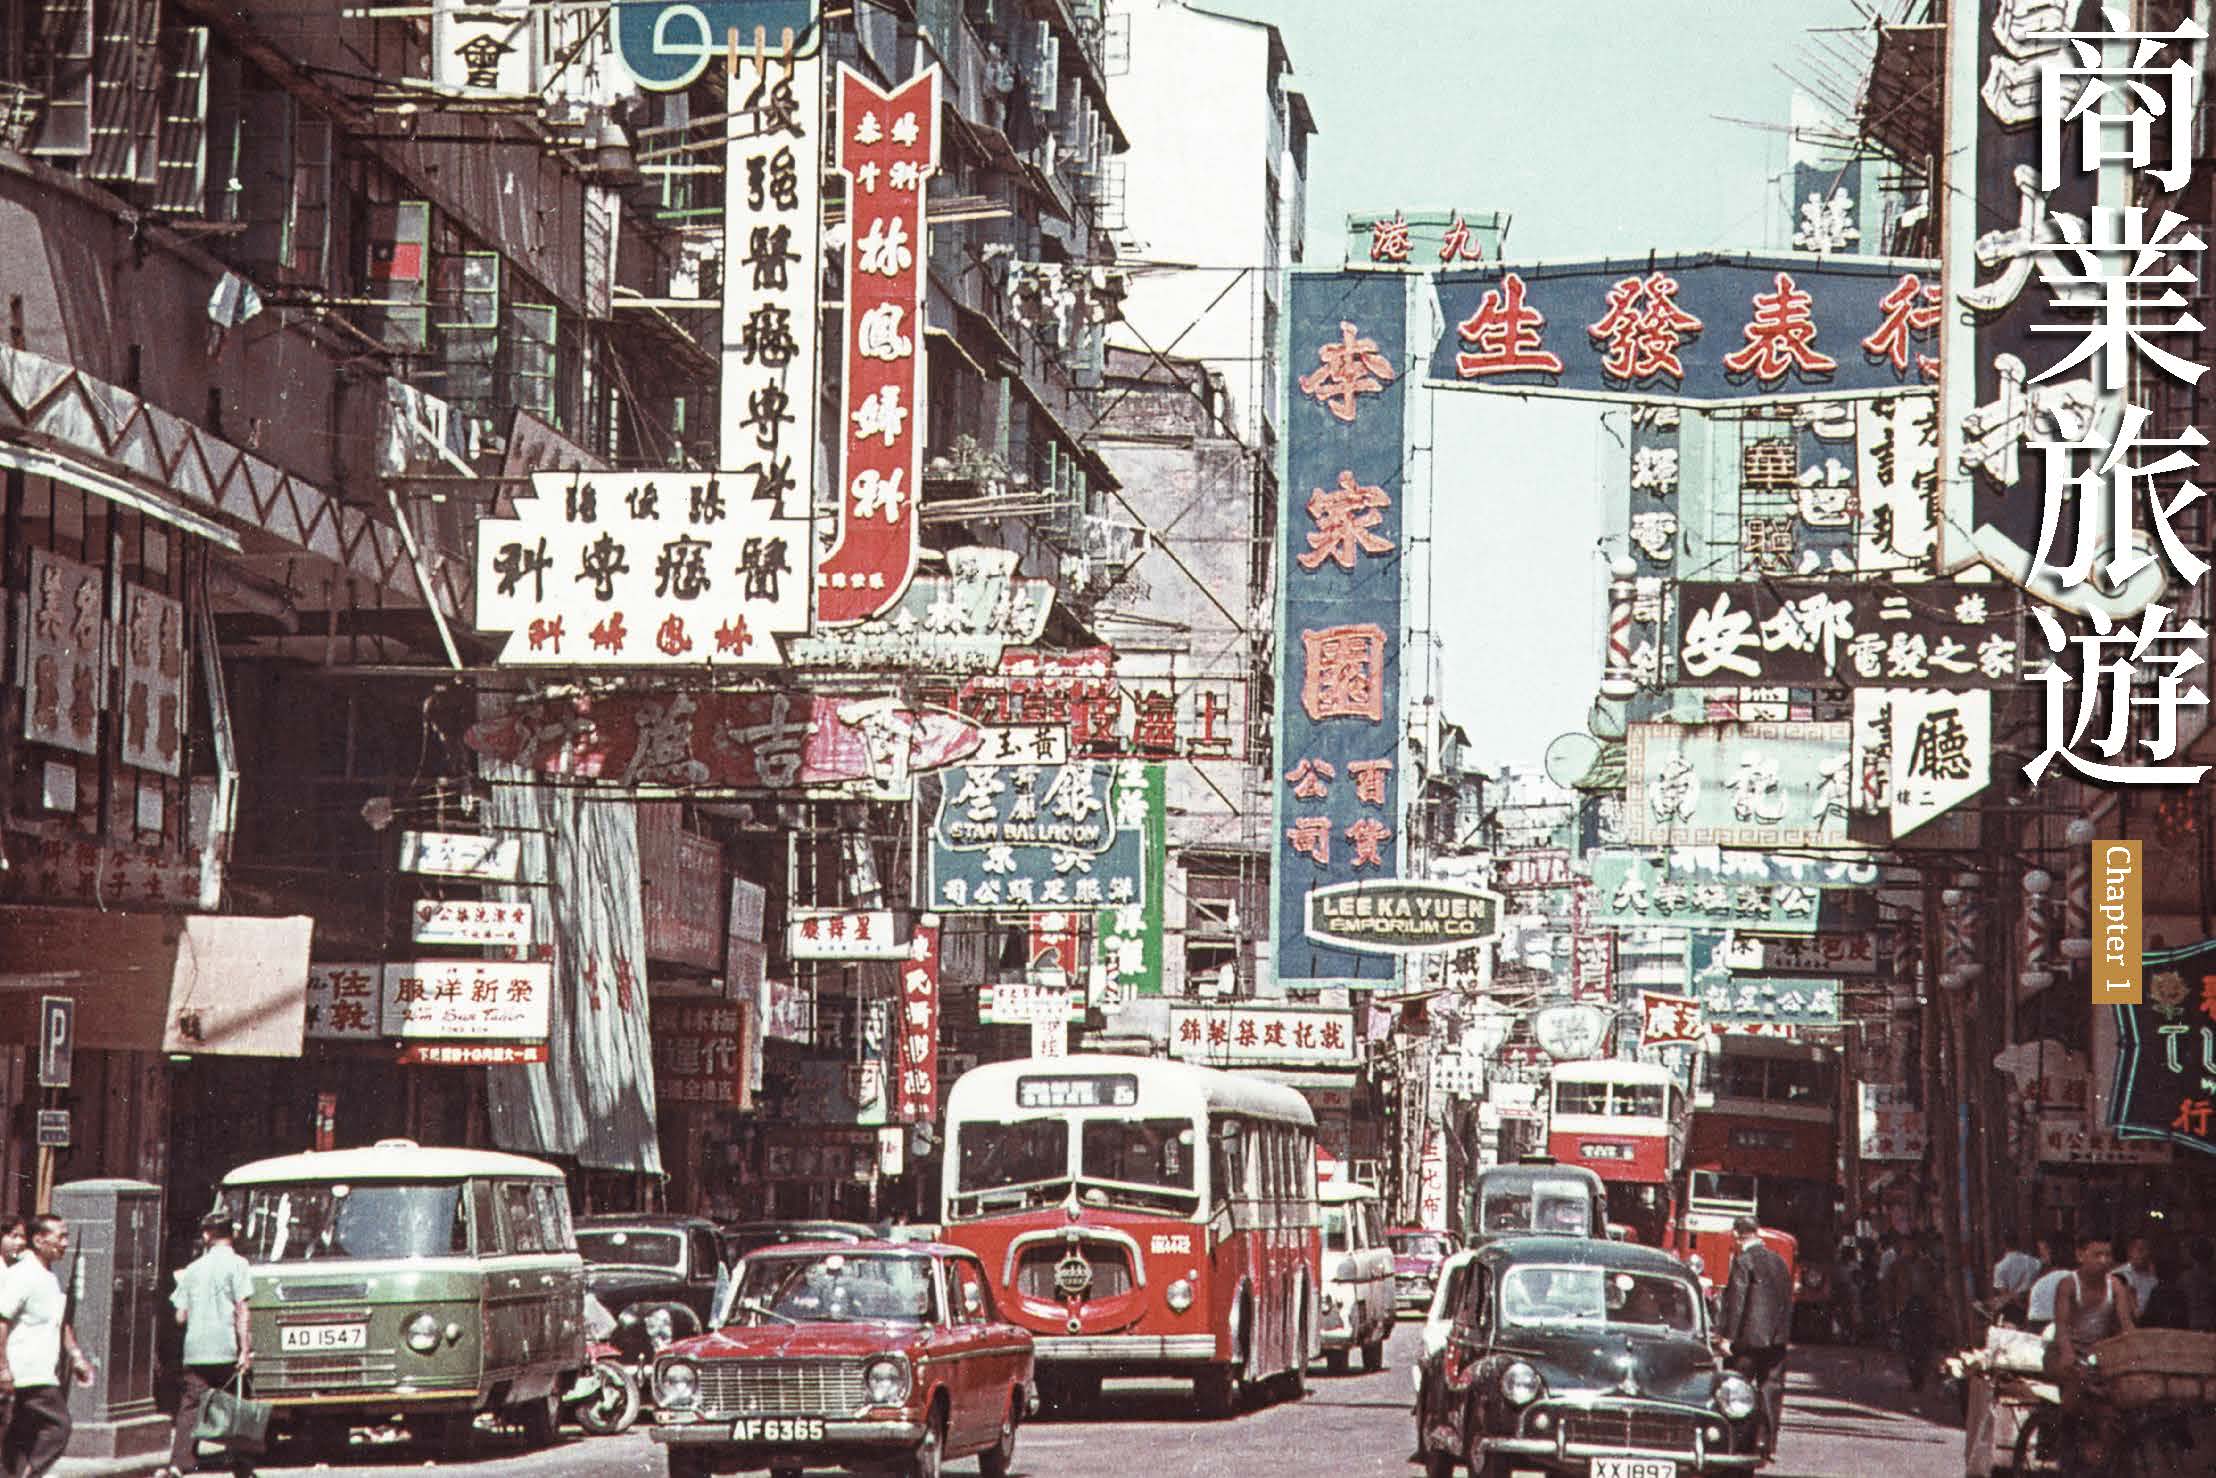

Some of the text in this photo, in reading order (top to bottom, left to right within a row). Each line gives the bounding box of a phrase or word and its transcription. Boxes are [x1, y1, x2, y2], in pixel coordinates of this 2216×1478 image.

[1879, 593, 1989, 625] 二樓
[1681, 591, 1854, 678] 安娜
[1848, 632, 2017, 679] 電髮之家
[1907, 707, 1972, 780] 廳
[950, 823, 997, 841] STAR
[1323, 897, 1486, 918] LEE KA YUEN
[1328, 918, 1481, 935] EMPORIUM CO.
[52, 1008, 67, 1076] P
[287, 1327, 363, 1346] AD 1547
